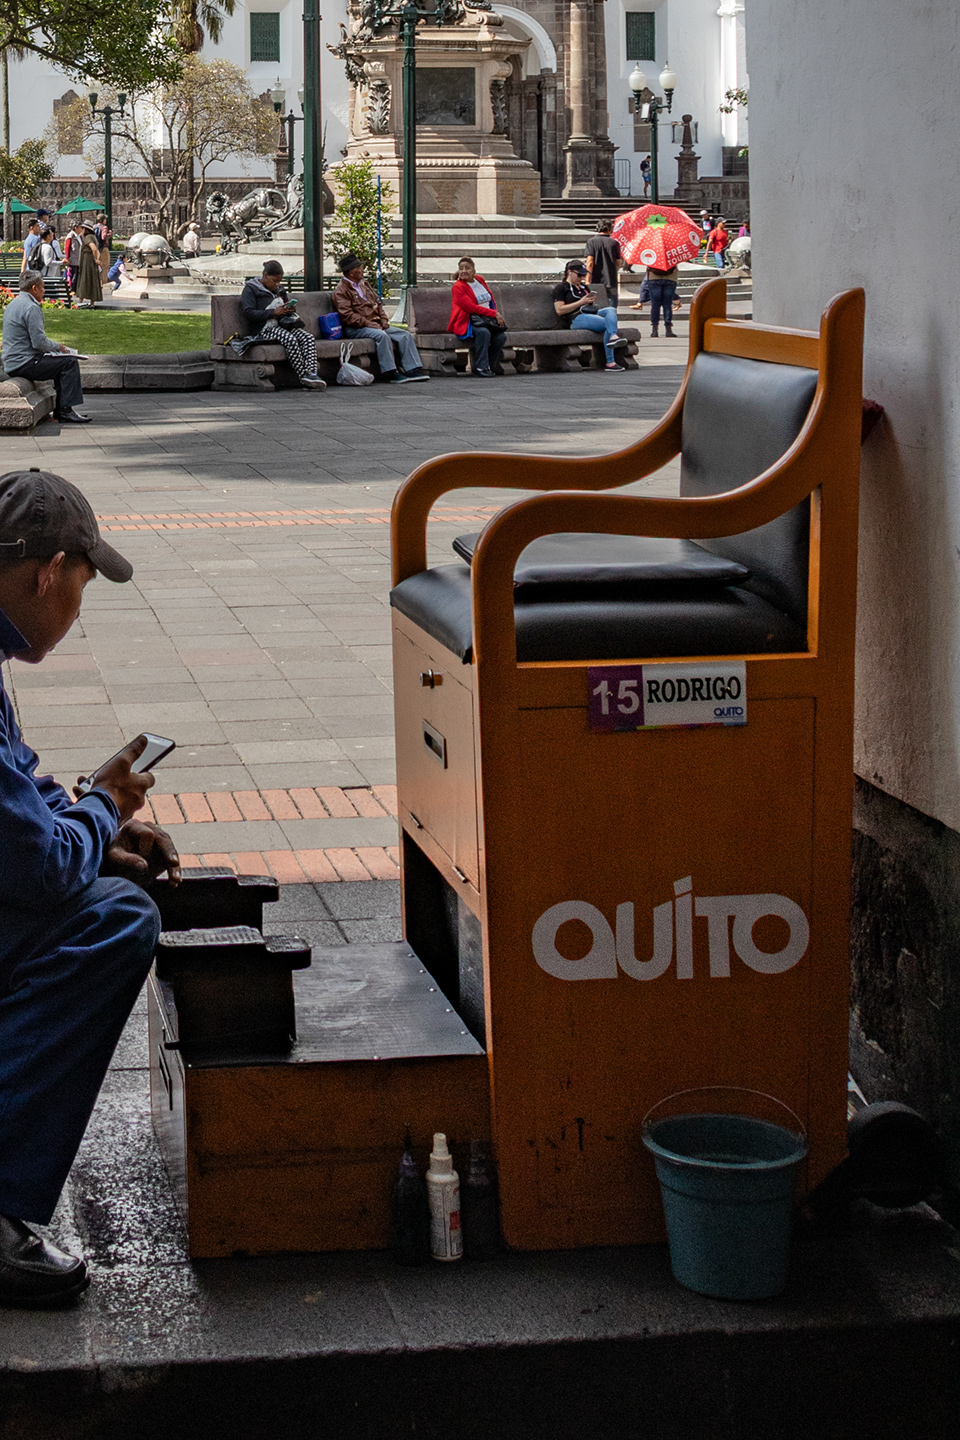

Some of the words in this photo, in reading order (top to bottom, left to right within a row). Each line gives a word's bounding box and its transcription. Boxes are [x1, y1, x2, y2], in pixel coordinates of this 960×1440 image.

[618, 233, 634, 251] TOURS
[666, 243, 688, 259] FREE
[667, 251, 692, 266] TOURS
[593, 679, 640, 715] 15
[646, 675, 741, 704] RODRIGO
[713, 706, 744, 717] QUITO
[531, 875, 810, 981] QUITO
